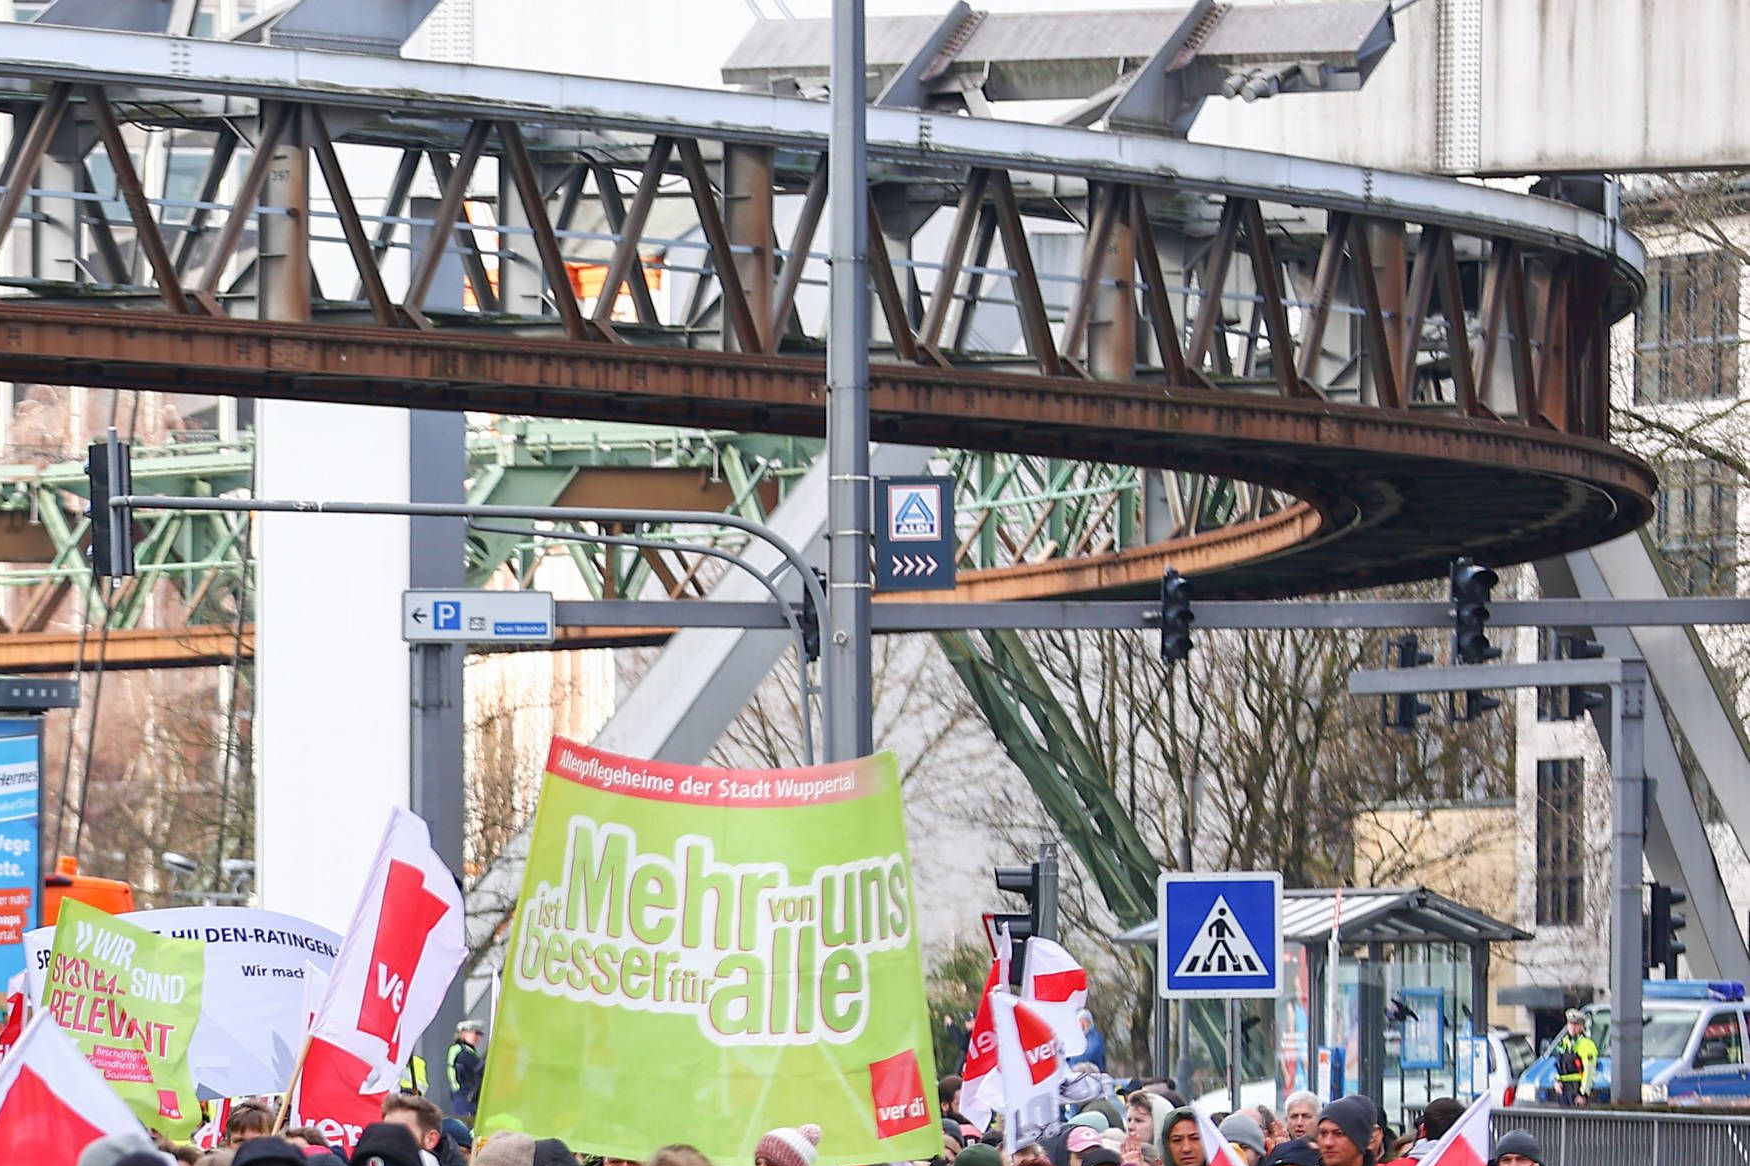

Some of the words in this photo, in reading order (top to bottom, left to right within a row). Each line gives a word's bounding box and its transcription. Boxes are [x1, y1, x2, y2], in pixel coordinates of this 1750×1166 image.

[900, 523, 929, 533] ALDI
[438, 603, 456, 628] P
[558, 749, 674, 793] Altenpflegeheime
[680, 775, 713, 797] der
[718, 778, 772, 799] Stadt
[776, 770, 855, 801] Wuppertal
[563, 822, 781, 953] Mehr
[767, 891, 817, 923] von
[820, 860, 909, 948] uns
[536, 890, 564, 930] ist
[241, 964, 268, 977] Wir
[519, 907, 681, 1003] besser
[130, 966, 186, 1004] SIND
[668, 965, 716, 1005] für
[707, 924, 865, 1036] alle
[879, 1096, 925, 1122] ver.di
